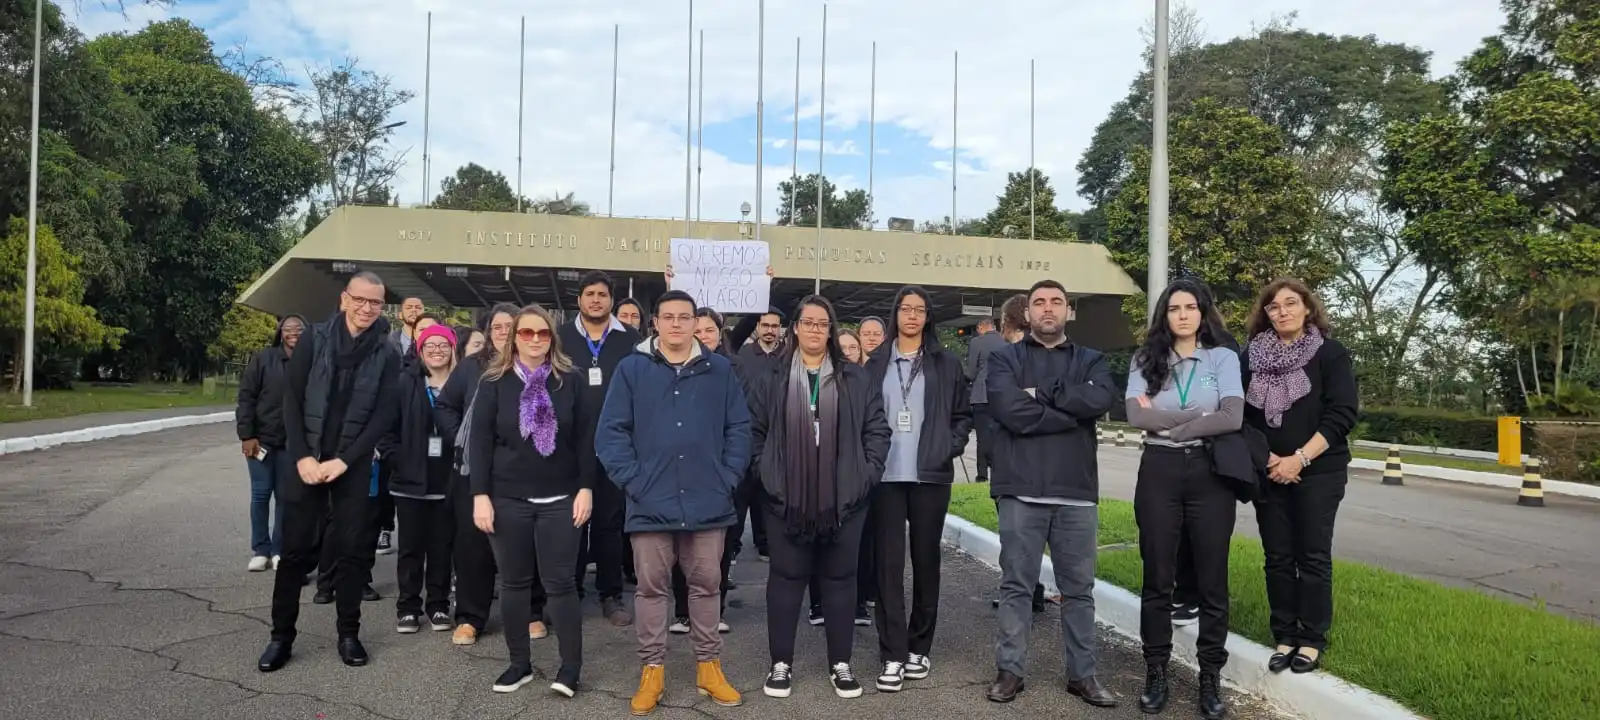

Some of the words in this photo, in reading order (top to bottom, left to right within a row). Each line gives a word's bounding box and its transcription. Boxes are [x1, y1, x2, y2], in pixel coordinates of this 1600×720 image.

[465, 230, 577, 249] INSTITUTO
[784, 245, 887, 264] PESQUISAS
[911, 253, 1004, 269] ESPACIAIS
[1019, 259, 1050, 271] INPE
[677, 243, 768, 268] QUEREMOS
[695, 265, 753, 287] NOSSO
